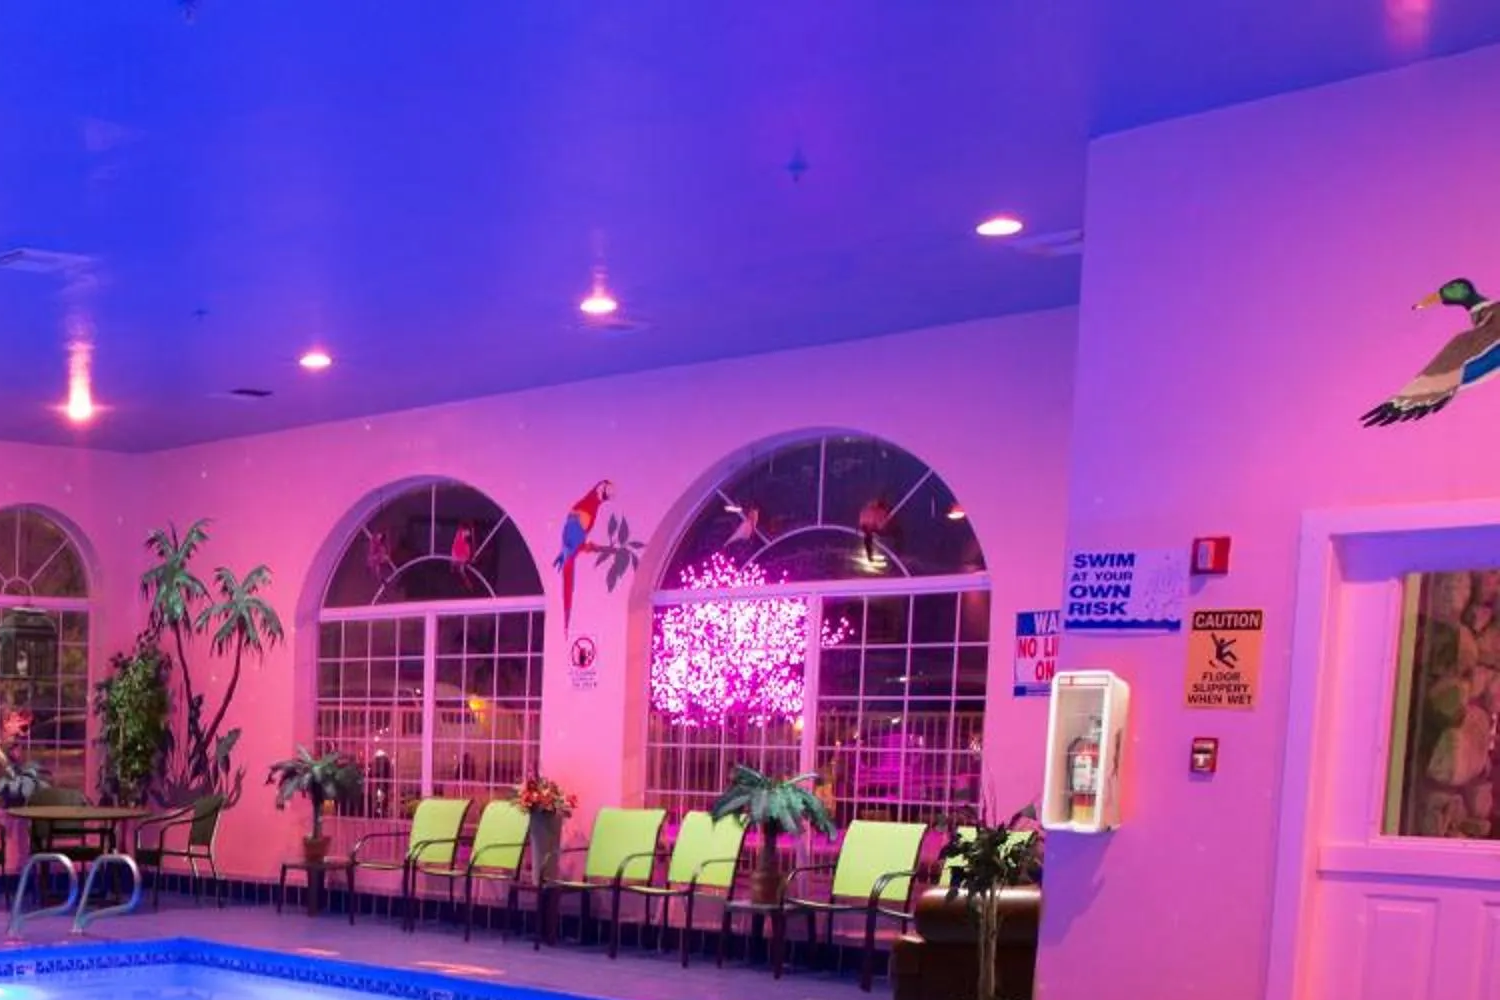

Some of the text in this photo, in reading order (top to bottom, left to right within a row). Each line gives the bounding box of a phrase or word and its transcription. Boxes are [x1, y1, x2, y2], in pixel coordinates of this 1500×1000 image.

[1073, 553, 1135, 568] SWIM
[1071, 571, 1133, 581] AT YOUR
[1069, 585, 1131, 598] OWN
[1068, 601, 1127, 615] RISK
[1195, 613, 1260, 628] CAUTION
[1018, 638, 1037, 658] NO
[1035, 660, 1055, 680] ON
[1202, 672, 1240, 681] FLOOR
[1192, 684, 1249, 692] SLIPPERY
[1188, 694, 1252, 704] WHEN WET
